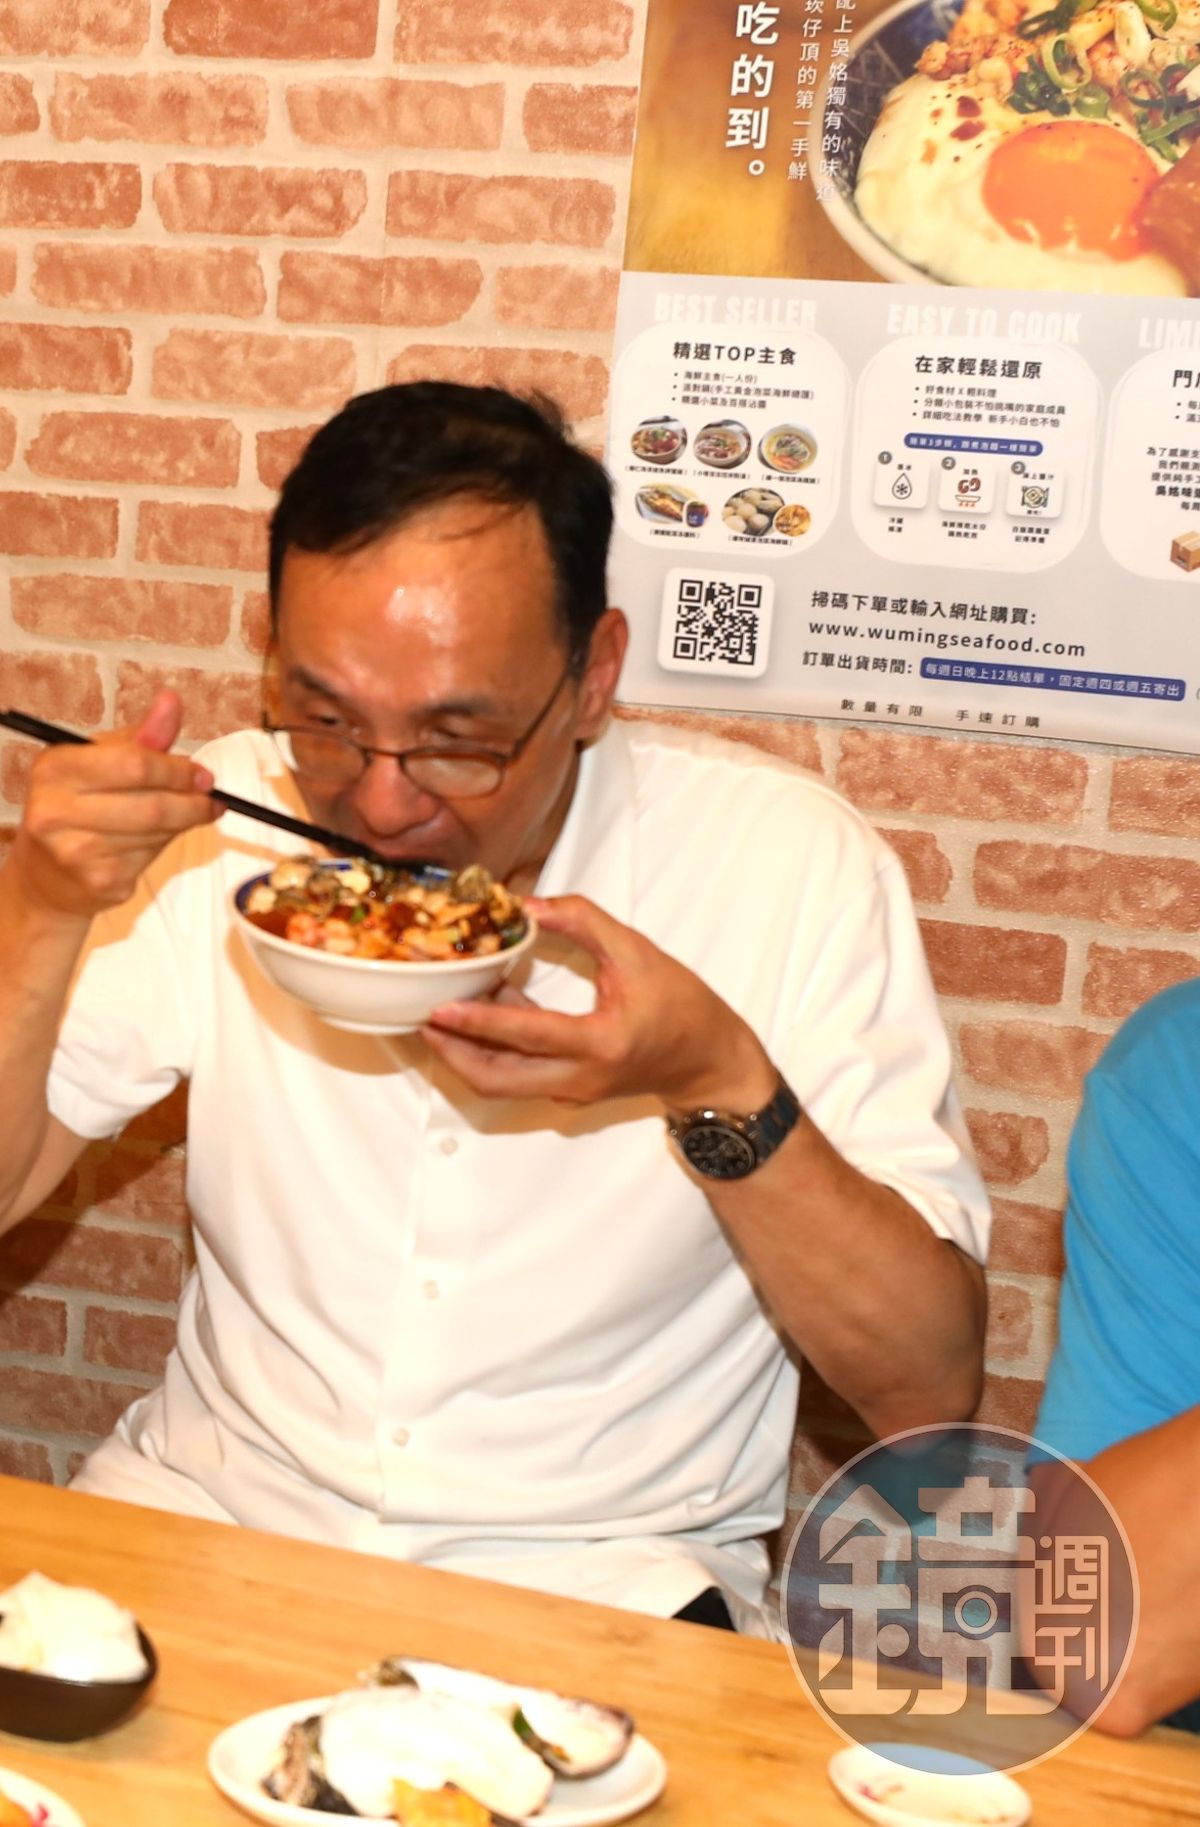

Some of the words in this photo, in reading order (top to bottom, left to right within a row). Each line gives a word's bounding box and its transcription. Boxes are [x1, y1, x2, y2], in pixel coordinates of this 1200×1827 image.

[725, 1, 781, 176] 吃的到。
[655, 293, 716, 325] BEST
[725, 297, 818, 331] SELLER
[888, 304, 956, 336] EASY
[965, 307, 998, 338] TO
[1007, 309, 1081, 343] COOK
[673, 341, 796, 366] 精選TOP主食
[915, 355, 1043, 379] 在家輕鬆還原
[810, 589, 1036, 625] 掃碼下單或輸入網址購買:
[808, 619, 1085, 657] www.wumingseafood.com
[801, 650, 912, 675] 訂單出貨時間:
[840, 697, 923, 717] 數量有限
[954, 708, 1039, 729] 手速訂購
